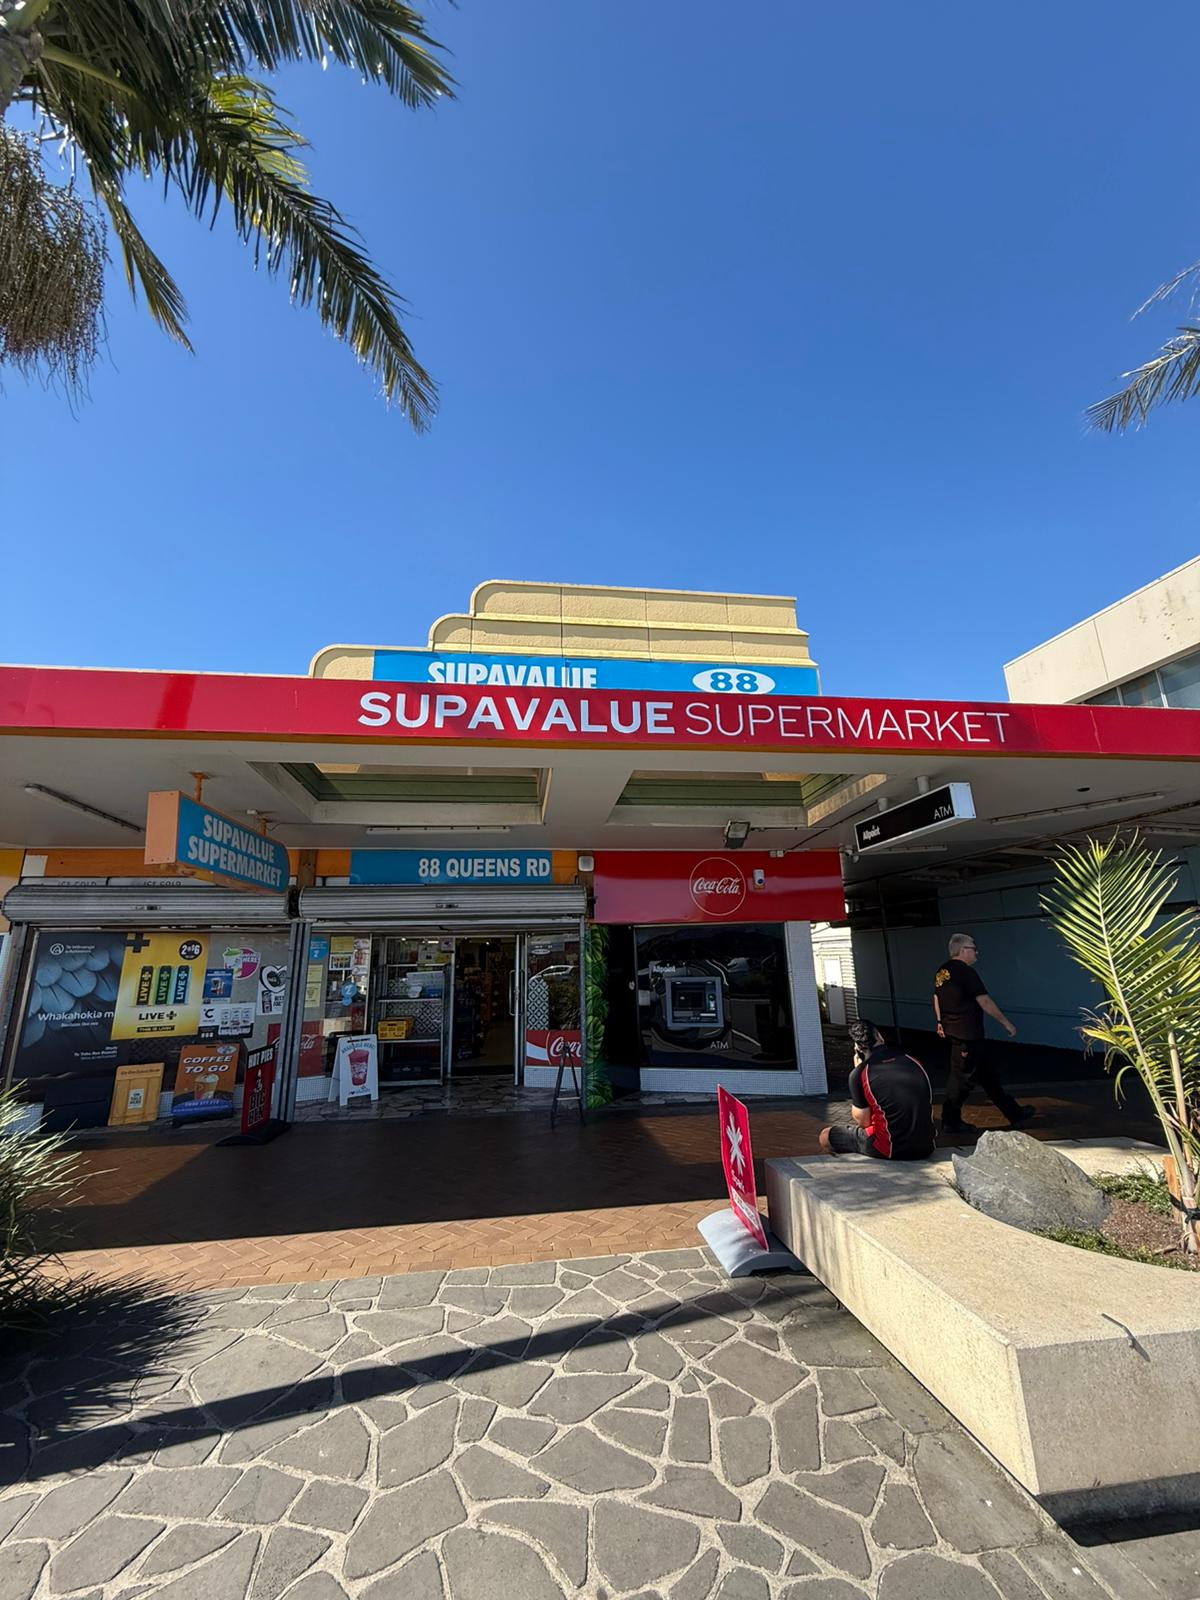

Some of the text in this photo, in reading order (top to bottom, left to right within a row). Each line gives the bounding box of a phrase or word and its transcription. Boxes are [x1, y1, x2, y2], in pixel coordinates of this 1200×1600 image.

[427, 661, 597, 688] SUPAVALUE
[711, 671, 759, 692] 88
[357, 691, 1010, 743] SUPAVALUE SUPERMARKET
[933, 804, 953, 821] ATM
[203, 814, 275, 864] SUPAVALUE
[187, 835, 282, 888] SUPERMARKET
[418, 858, 551, 879] 88 QUEENS RD
[693, 877, 742, 895] Coca-Cola
[38, 1011, 103, 1021] Whakahokia
[709, 1040, 730, 1049] ATM
[182, 1055, 233, 1065] COFFEE
[184, 1064, 230, 1074] TO GO
